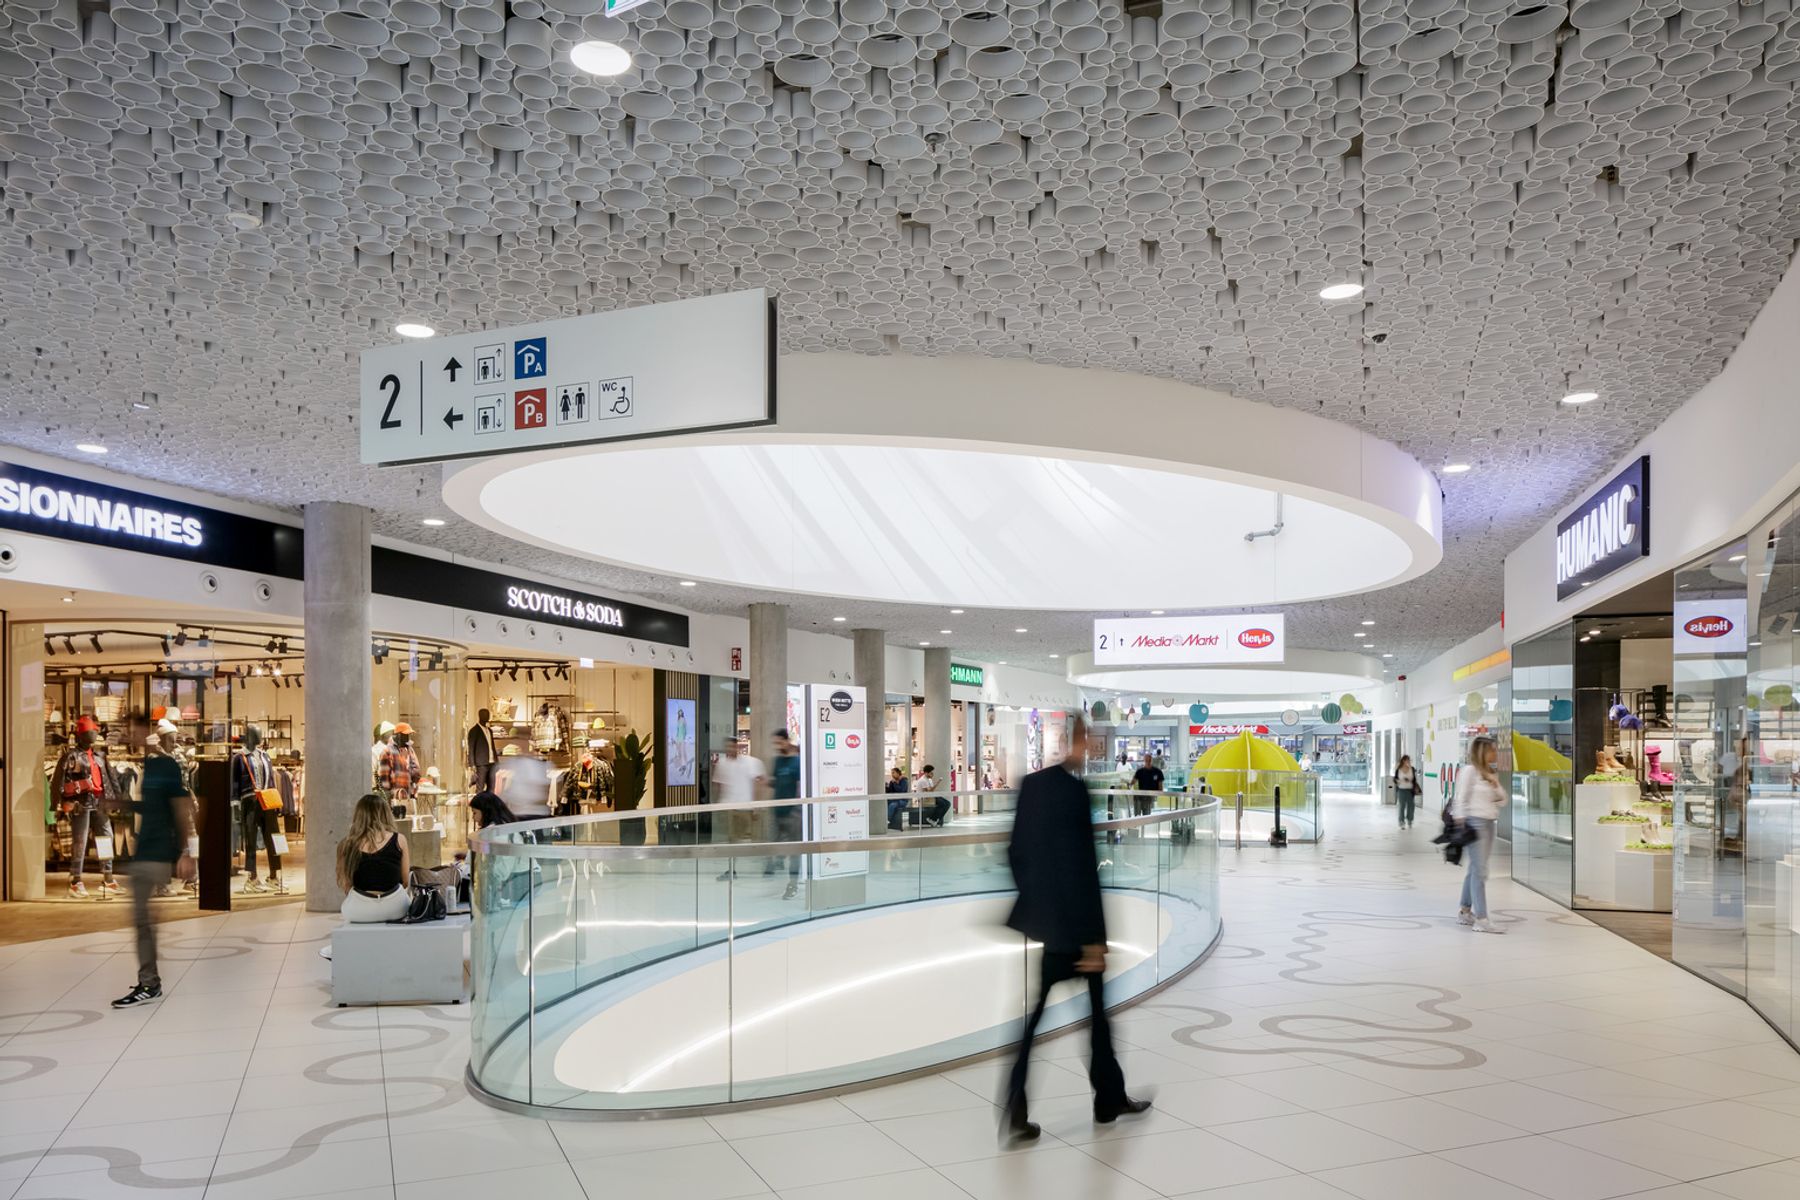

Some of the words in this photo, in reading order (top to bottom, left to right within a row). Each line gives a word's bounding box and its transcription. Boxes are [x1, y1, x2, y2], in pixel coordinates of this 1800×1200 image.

[379, 373, 402, 430] 2
[601, 381, 618, 393] WC
[0, 478, 204, 547] SIONNAIRES
[1557, 484, 1633, 584] HUMANIC
[507, 586, 571, 617] SCOTCH
[586, 602, 623, 627] SODA
[1099, 634, 1108, 650] 2
[1131, 634, 1172, 648] Media
[1181, 633, 1220, 647] Markt
[1241, 631, 1273, 646] Hervis
[950, 667, 982, 683] HMANN
[820, 707, 831, 722] E2
